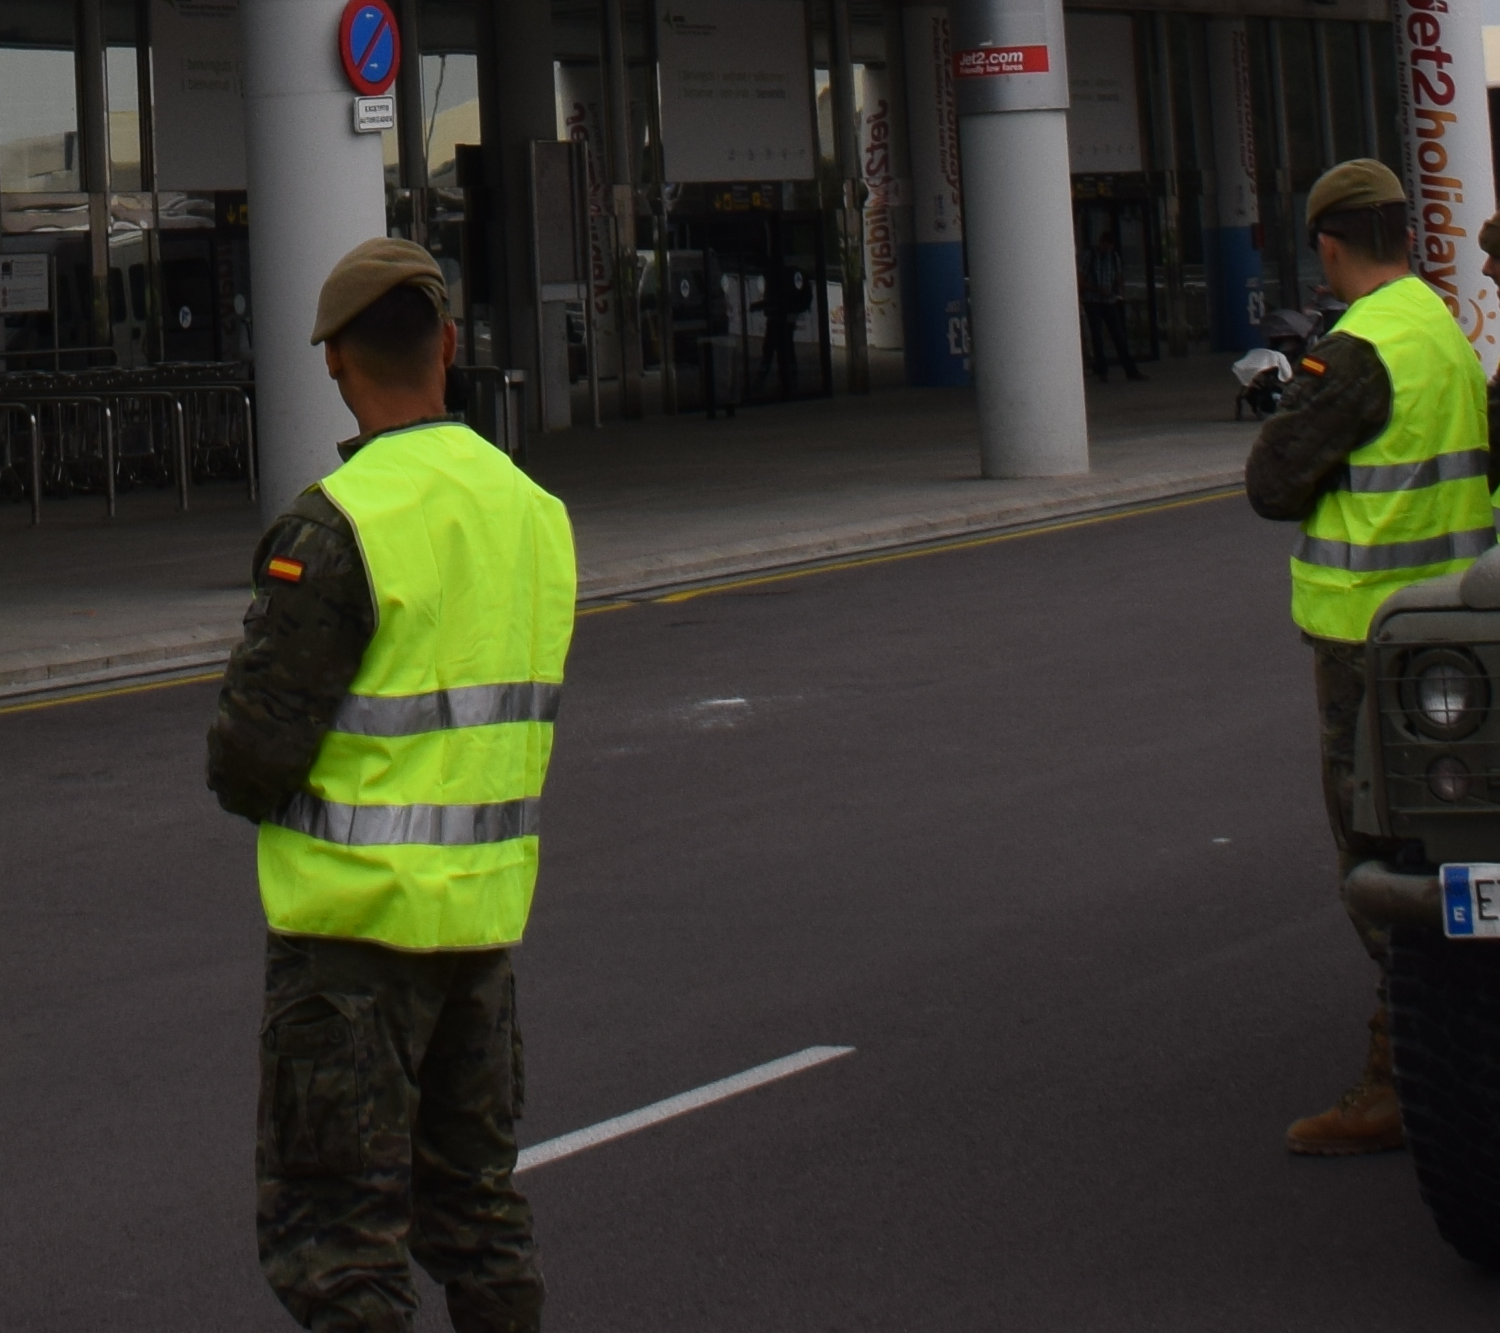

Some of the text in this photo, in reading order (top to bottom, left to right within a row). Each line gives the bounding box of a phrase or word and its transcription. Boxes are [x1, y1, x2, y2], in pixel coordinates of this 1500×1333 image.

[959, 51, 1024, 66] Jet2.com
[1397, 61, 1411, 136] holidays
[1404, 141, 1413, 173] you
[1453, 905, 1466, 923] E
